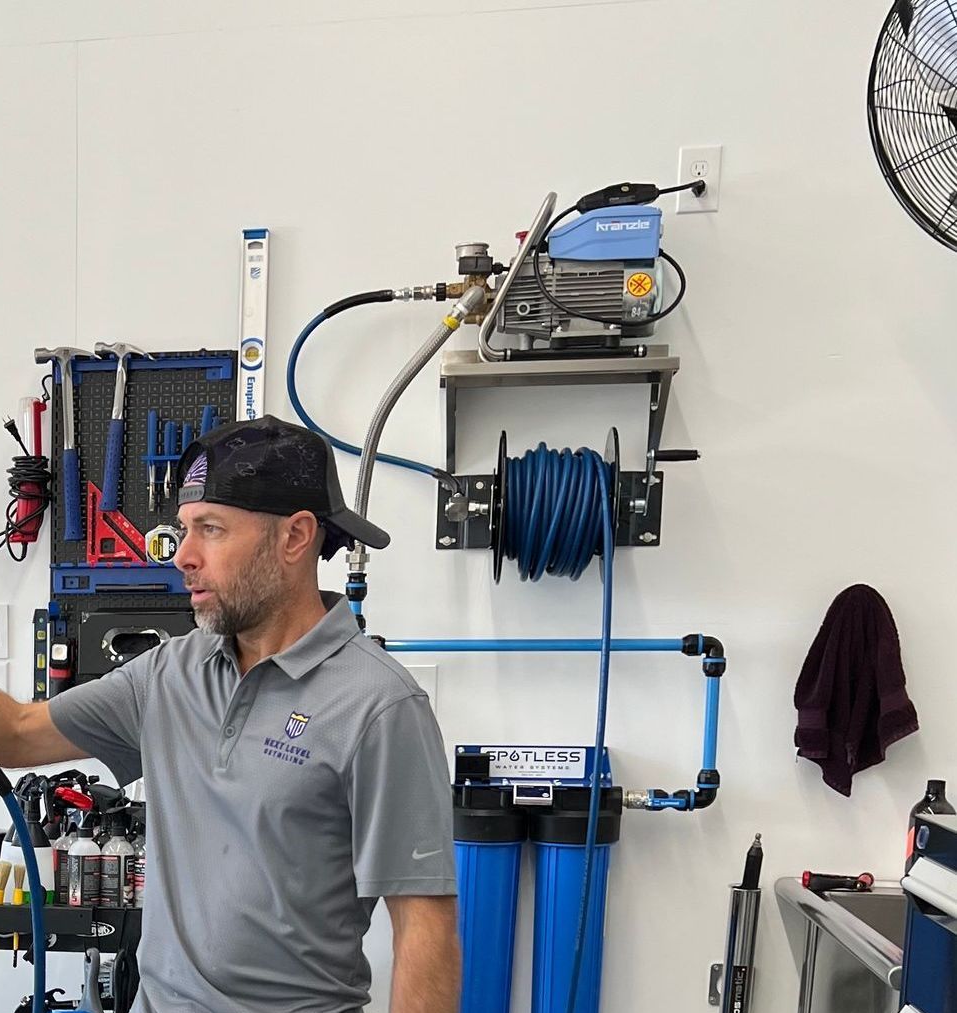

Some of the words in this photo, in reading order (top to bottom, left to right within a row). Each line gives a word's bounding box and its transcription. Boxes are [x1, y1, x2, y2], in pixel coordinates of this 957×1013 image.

[245, 376, 256, 415] Empire
[263, 748, 305, 766] DETAILING
[264, 737, 285, 750] NEXT
[285, 744, 311, 759] LEVEL
[486, 750, 581, 762] SPOTLESS
